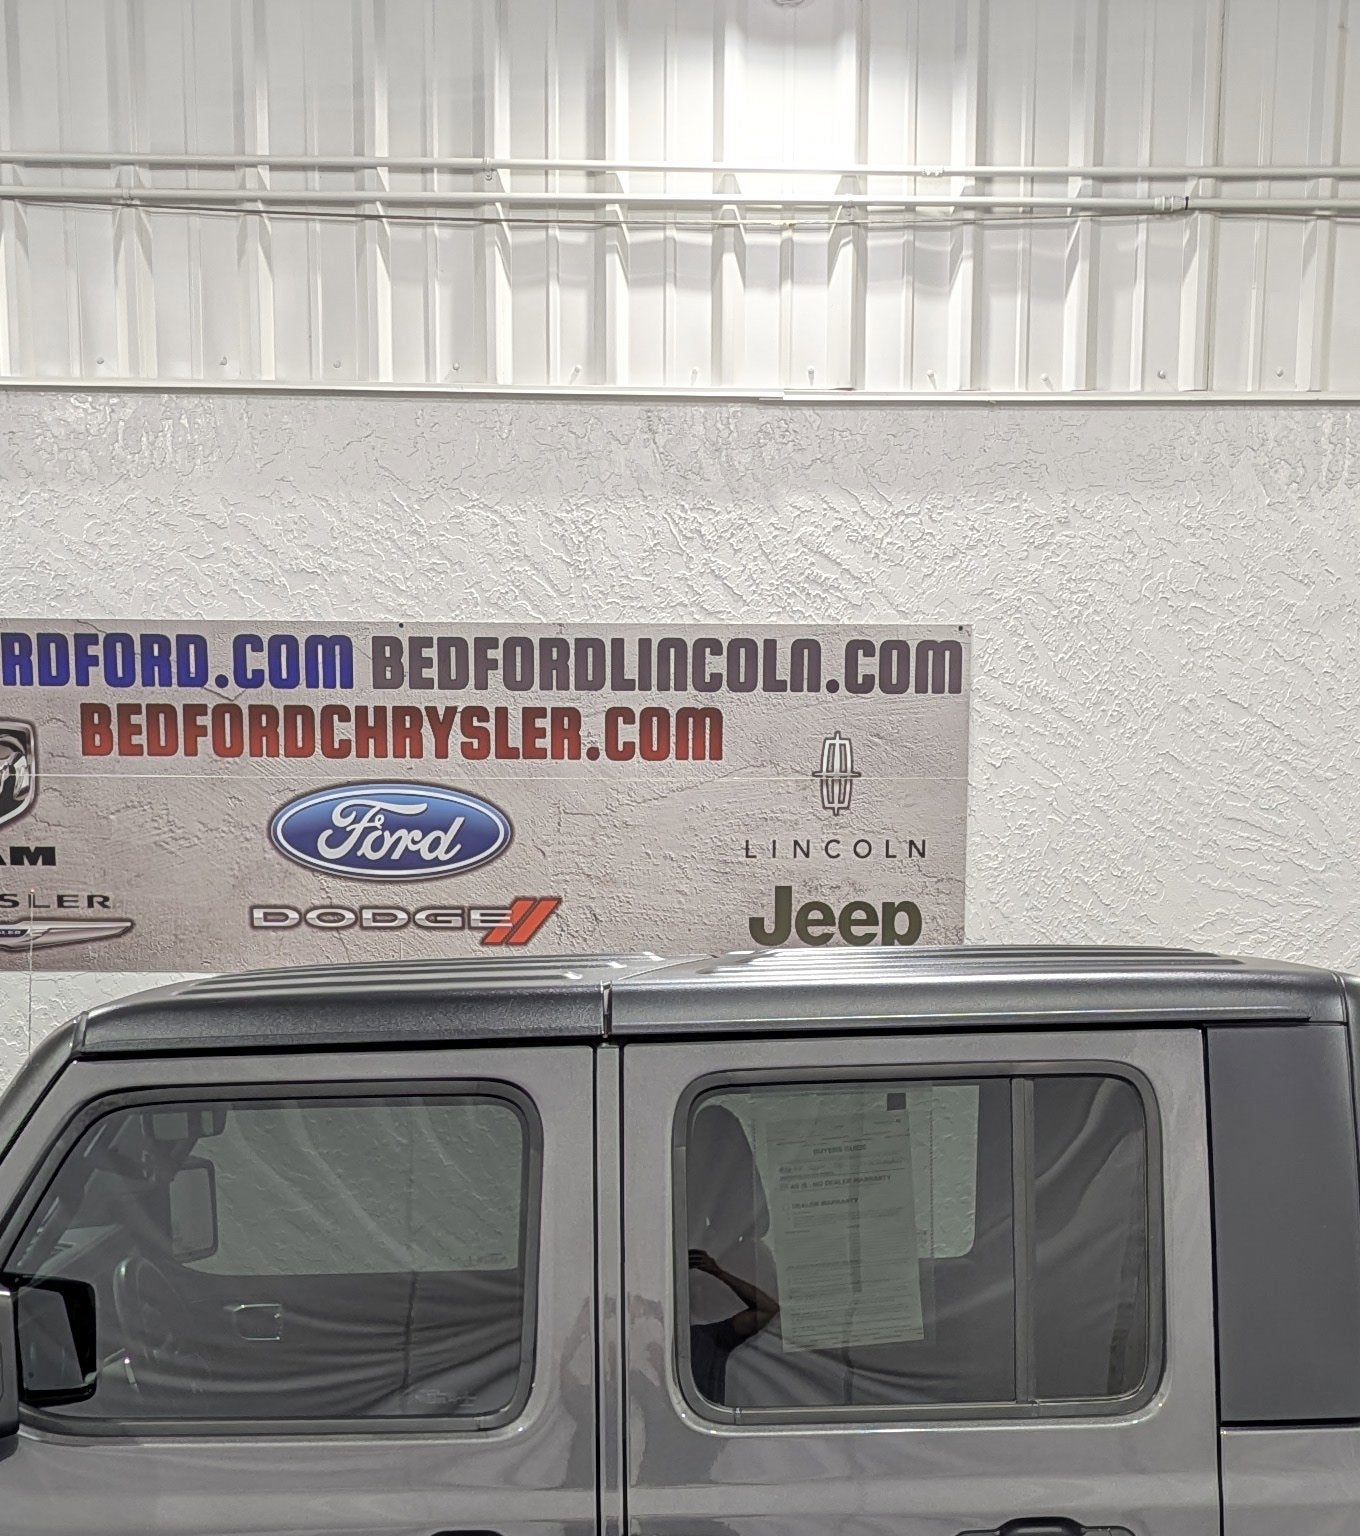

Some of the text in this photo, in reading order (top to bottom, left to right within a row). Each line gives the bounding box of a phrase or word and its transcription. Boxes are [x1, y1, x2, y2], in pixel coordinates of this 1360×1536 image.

[371, 635, 963, 695] BEDFORDLINCOLN.COM
[79, 702, 725, 763] BEDFORDCHRYSLER.COM
[316, 798, 466, 861] Ford
[744, 838, 926, 860] LINCOLN
[251, 906, 514, 929] DODGE
[748, 885, 924, 947] Jeep
